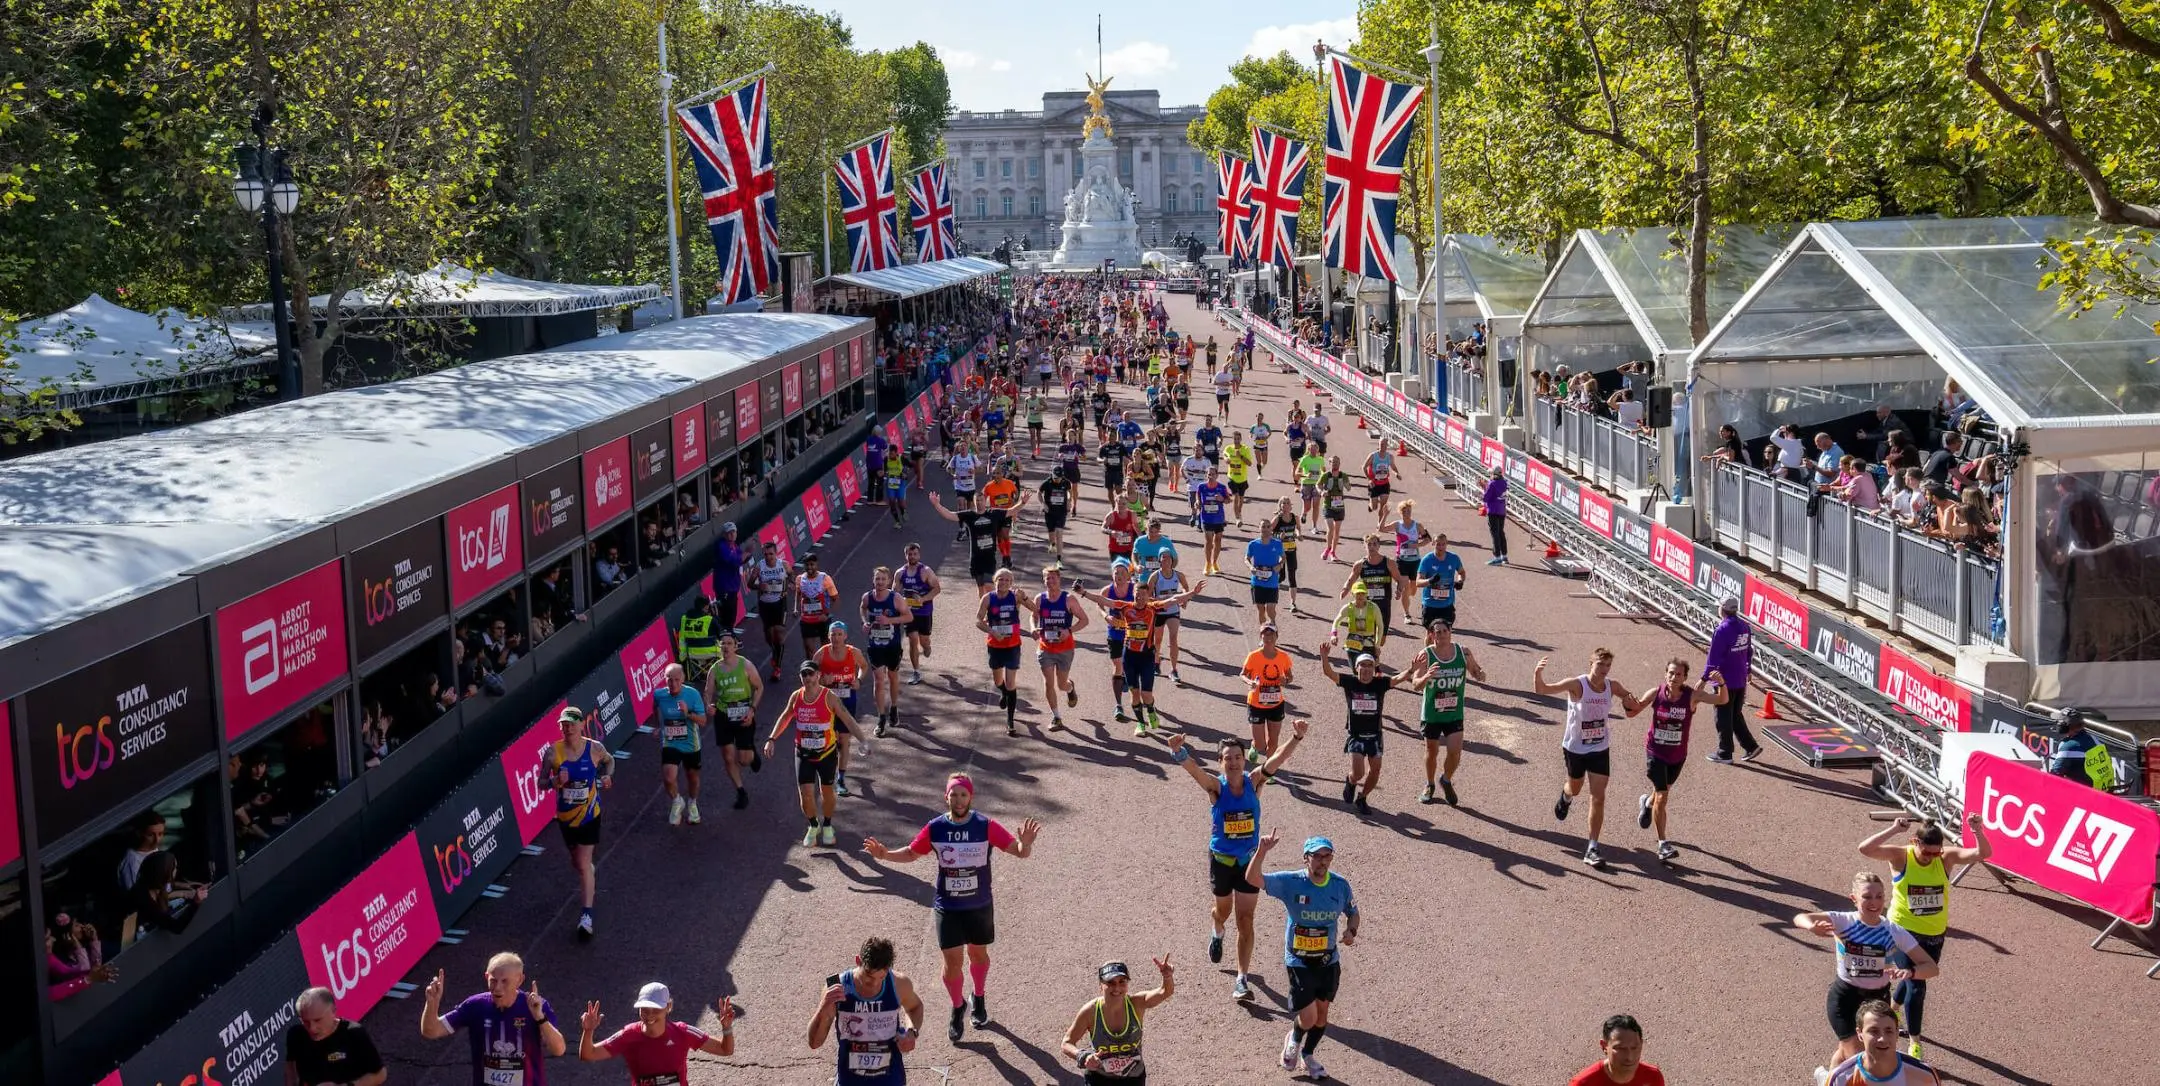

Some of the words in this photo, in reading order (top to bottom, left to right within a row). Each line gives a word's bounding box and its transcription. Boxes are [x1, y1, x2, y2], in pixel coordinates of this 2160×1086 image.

[531, 499, 550, 536] tcs
[459, 525, 485, 572] tcs
[394, 558, 412, 577] TATA
[396, 565, 433, 595] CONSULTANCY
[1720, 571, 1741, 596] LONDON
[280, 601, 311, 627] ABBOTT
[364, 576, 394, 626] tcs
[397, 587, 422, 612] SERVICES
[281, 619, 310, 643] WORLD
[1764, 614, 1802, 648] MARATHON
[1775, 604, 1802, 628] LONDON
[282, 626, 328, 660] MARATHON
[1845, 642, 1874, 670] LONDON
[284, 648, 317, 677] MAJORS
[1834, 653, 1874, 687] MARATHON
[117, 684, 149, 712] TATA
[630, 663, 652, 702] tcs
[1428, 676, 1464, 689] JOHN
[119, 687, 188, 736] CONSULTANCY
[1918, 684, 1959, 720] LONDON
[56, 714, 116, 790] tcs
[120, 722, 166, 761] SERVICES
[2022, 724, 2049, 756] tcs
[463, 808, 482, 831] TATA
[468, 806, 506, 848] CONSULTANCY
[1981, 776, 2046, 848] tcs
[472, 834, 498, 868] SERVICES
[947, 831, 969, 841] TOM
[434, 835, 472, 894] tcs
[952, 880, 972, 888] 2573
[362, 893, 388, 922] TATA
[368, 888, 419, 942] CONSULTANCY
[1301, 910, 1338, 921] CHUCHO
[1912, 895, 1940, 906] 26141
[374, 924, 408, 964] SERVICES
[321, 928, 371, 1000] tcs
[1852, 958, 1877, 968] 3813
[854, 1001, 883, 1013] MATT
[219, 1010, 254, 1048] TATA
[226, 998, 296, 1073] CONSULTANCY
[858, 1054, 882, 1066] 7977
[490, 1072, 514, 1084] 4427
